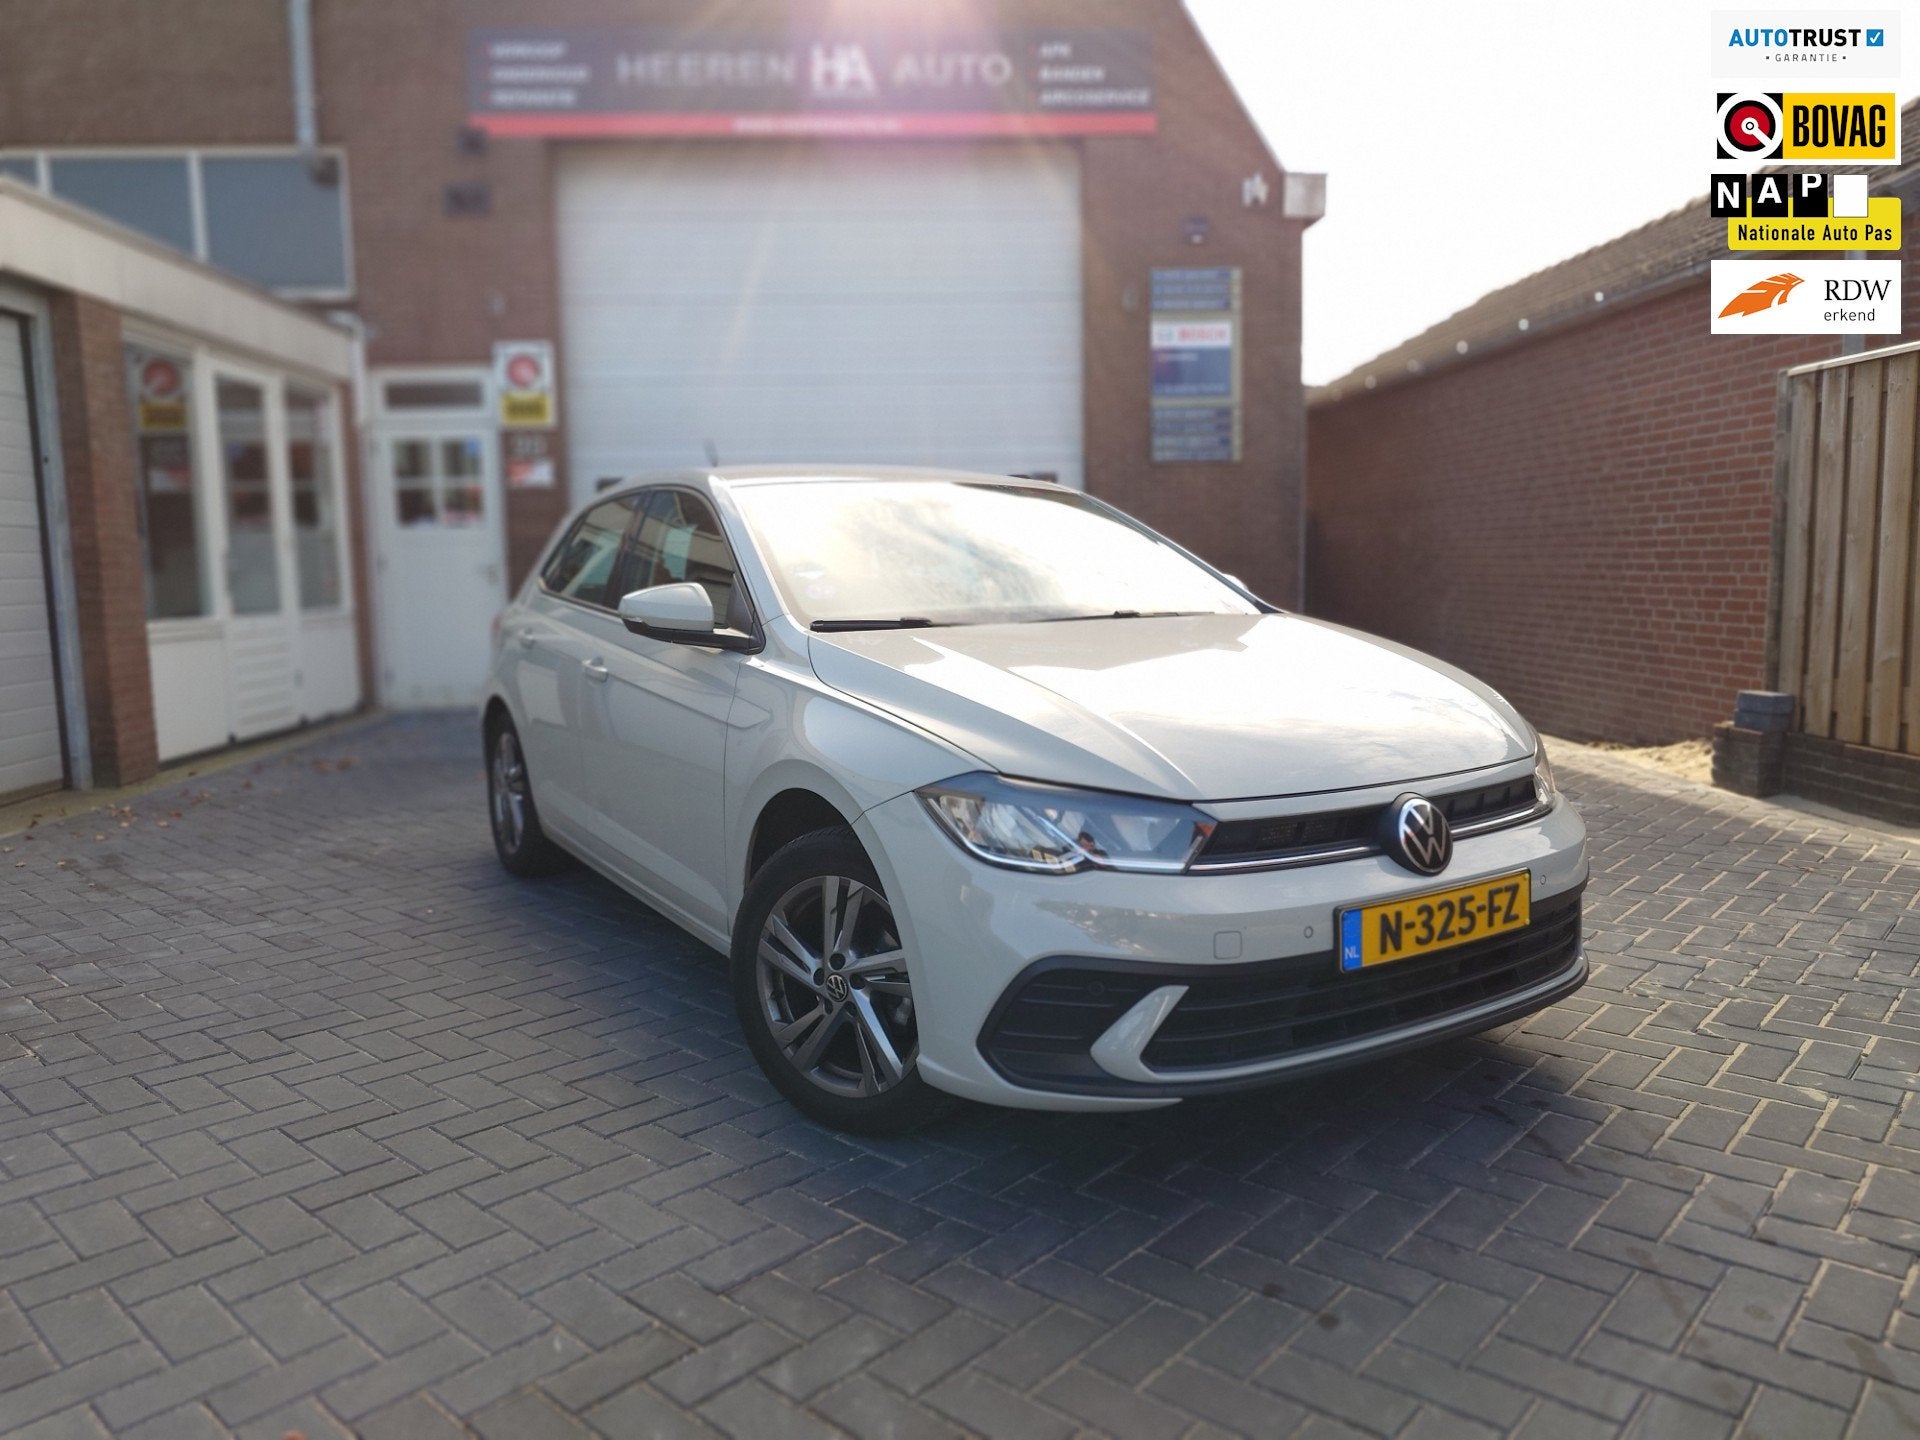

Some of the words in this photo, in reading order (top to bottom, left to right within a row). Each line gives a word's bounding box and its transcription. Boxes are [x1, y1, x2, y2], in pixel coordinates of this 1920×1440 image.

[616, 52, 797, 86] HEEREN
[893, 52, 1014, 86] AUTO
[1380, 883, 1520, 955] N-325-FZ
[1344, 946, 1360, 959] NL
